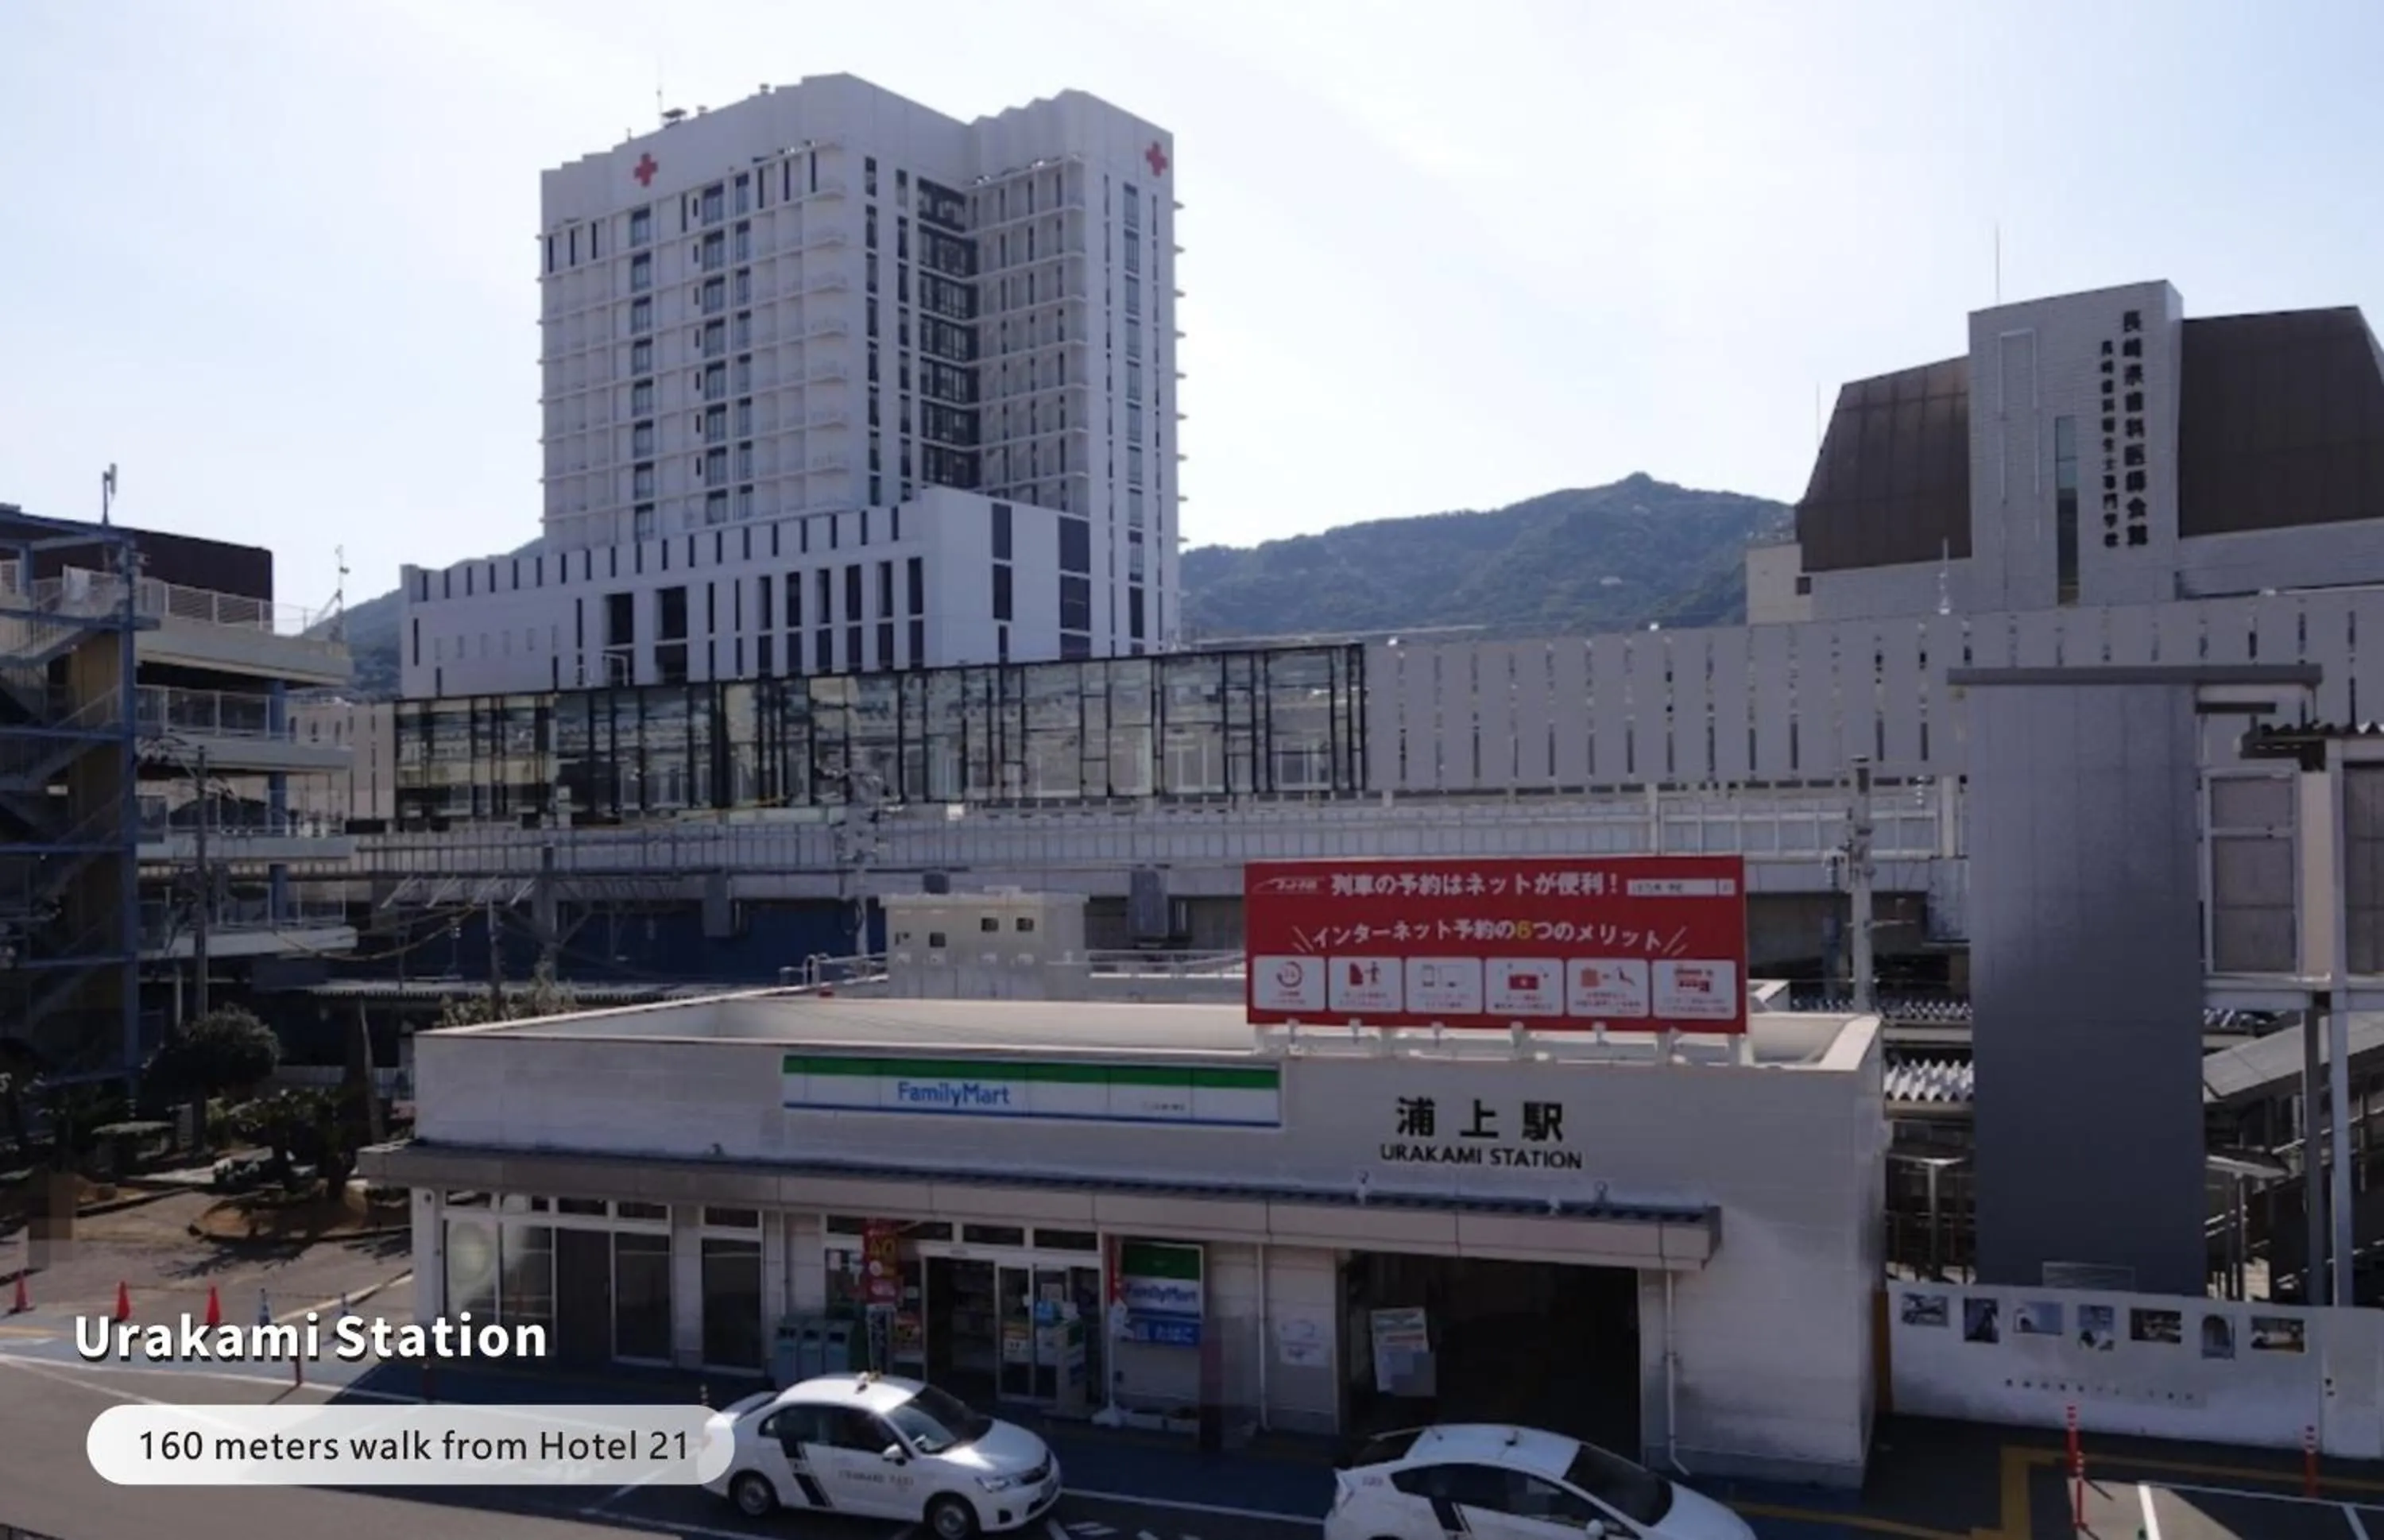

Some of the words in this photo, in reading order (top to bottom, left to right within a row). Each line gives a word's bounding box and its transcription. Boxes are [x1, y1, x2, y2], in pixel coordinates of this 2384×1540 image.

[1329, 871, 1618, 897] 列車の予約はネットが便利！
[1311, 919, 1663, 952] インターネット予約の6つのメリット
[897, 1079, 1010, 1109] FamilyMart
[1396, 1096, 1563, 1142] 浦上駅
[1380, 1143, 1482, 1165] URAKAMI
[1489, 1147, 1582, 1170] STATION
